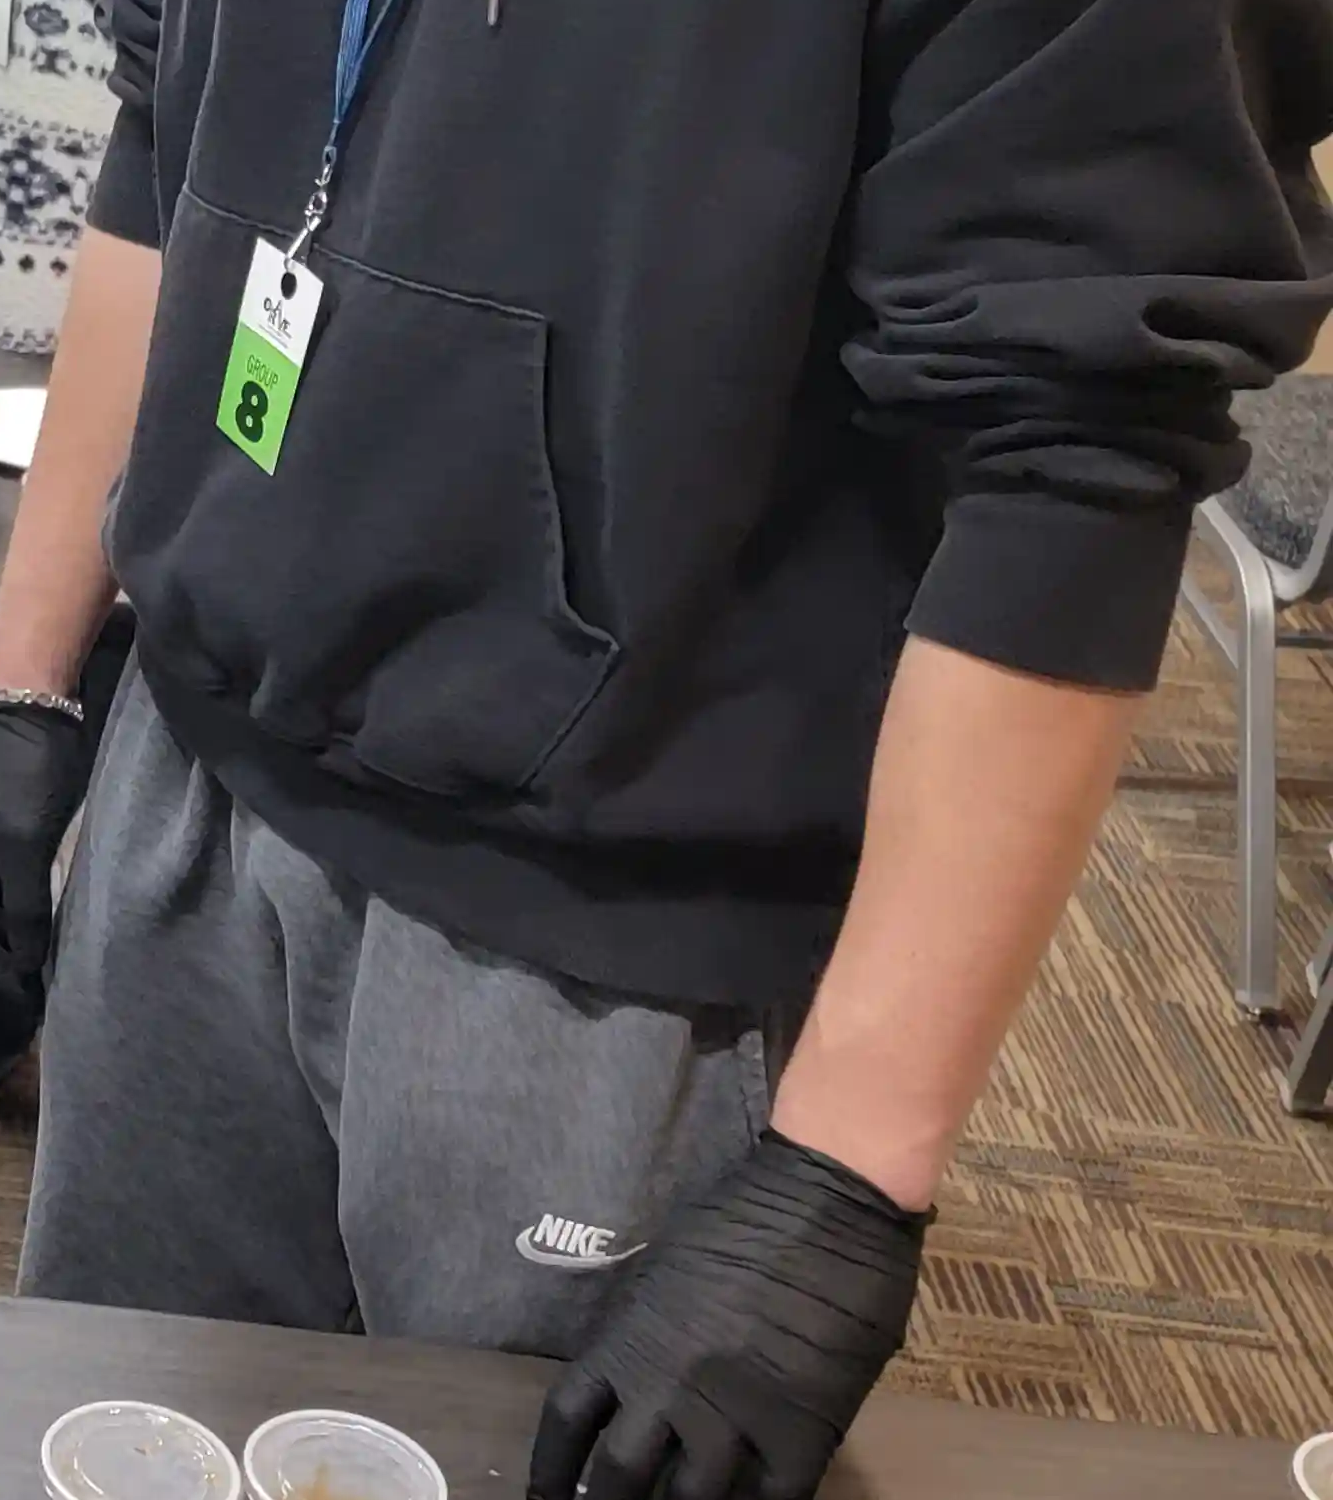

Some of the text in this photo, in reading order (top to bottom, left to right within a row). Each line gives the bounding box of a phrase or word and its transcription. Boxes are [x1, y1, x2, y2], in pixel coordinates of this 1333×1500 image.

[246, 354, 279, 391] GROUP
[235, 380, 269, 443] 8
[533, 1213, 617, 1257] NIKE
